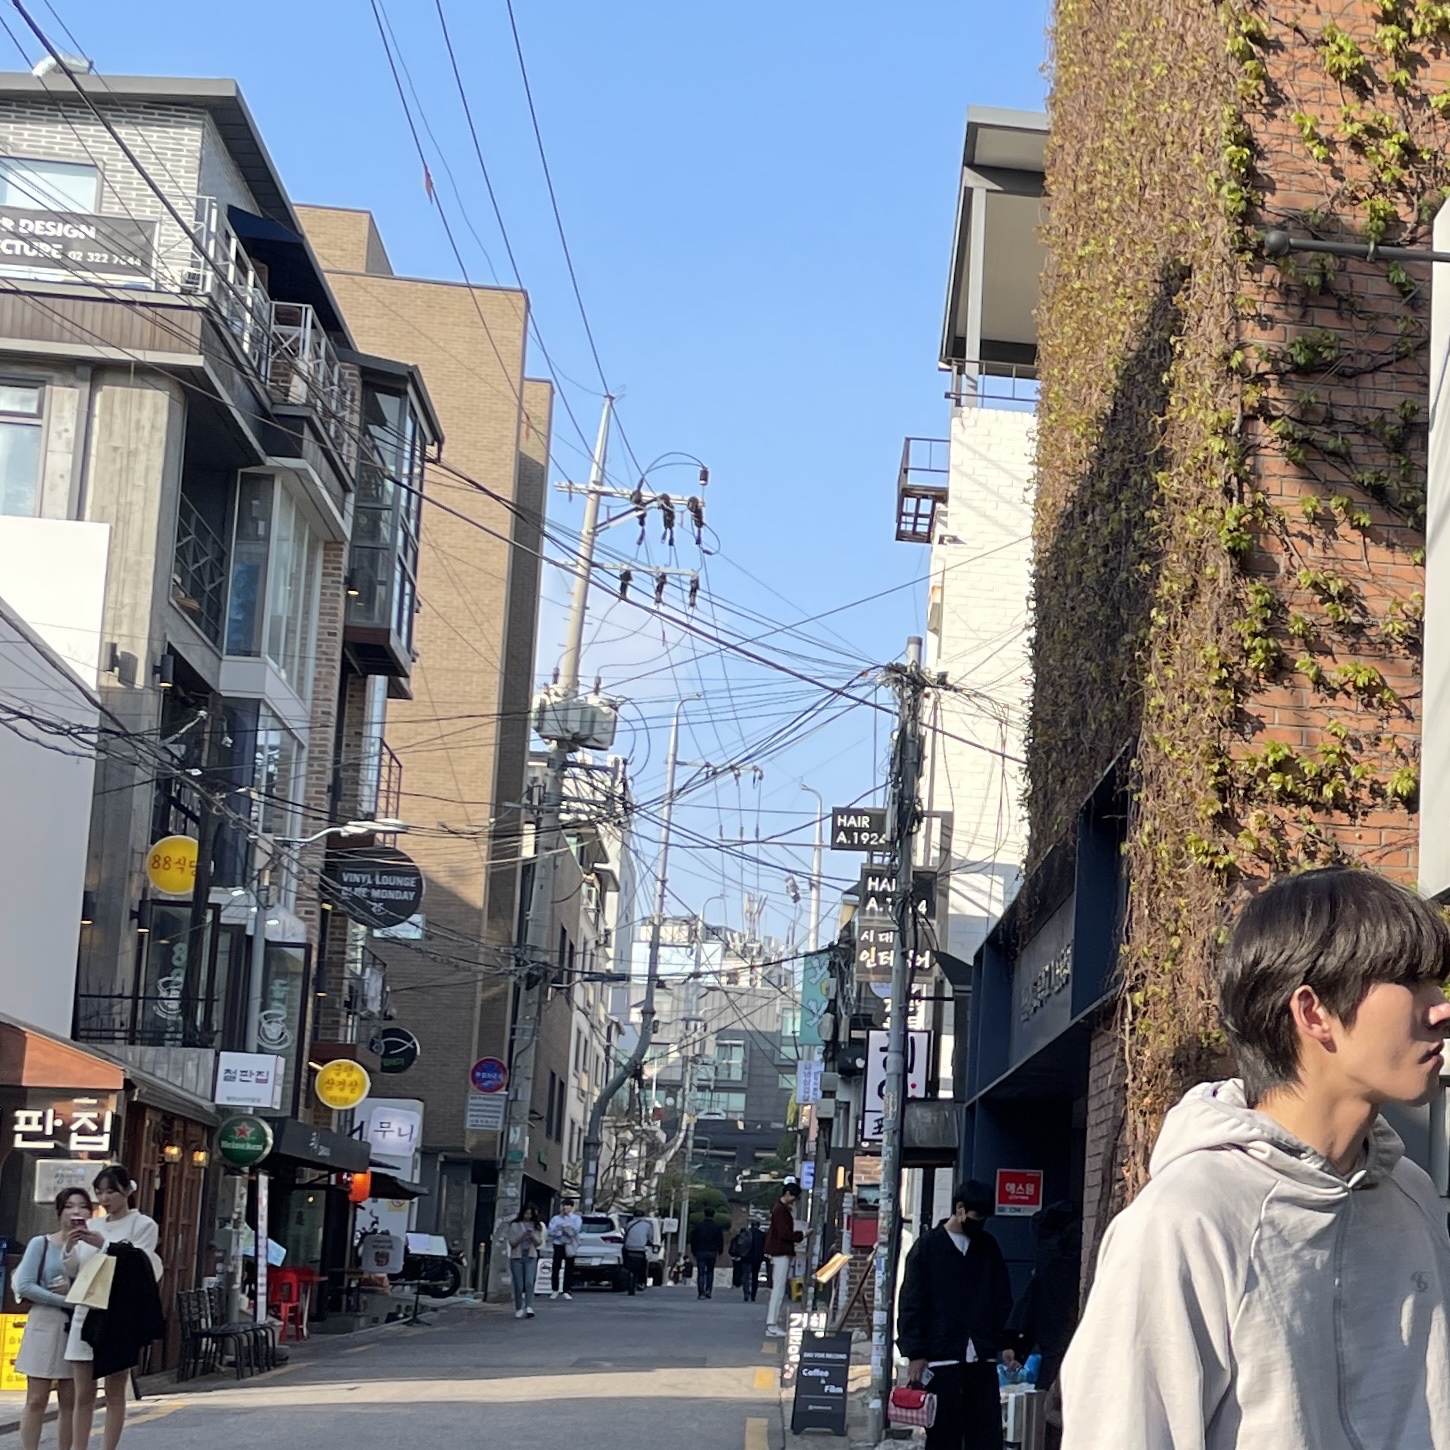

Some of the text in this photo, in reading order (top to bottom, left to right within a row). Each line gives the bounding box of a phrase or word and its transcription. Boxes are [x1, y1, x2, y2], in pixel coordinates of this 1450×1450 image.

[18, 219, 96, 239] DESIGN
[0, 239, 63, 259] CTURE
[68, 250, 83, 261] 02
[86, 252, 109, 263] 322
[837, 815, 870, 828] HAIR
[342, 872, 417, 887] VINYL LOUNGE
[867, 877, 896, 892] HAI
[371, 888, 416, 900] MONDAY
[373, 1121, 414, 1142] 무니
[802, 1368, 830, 1377] Coffee
